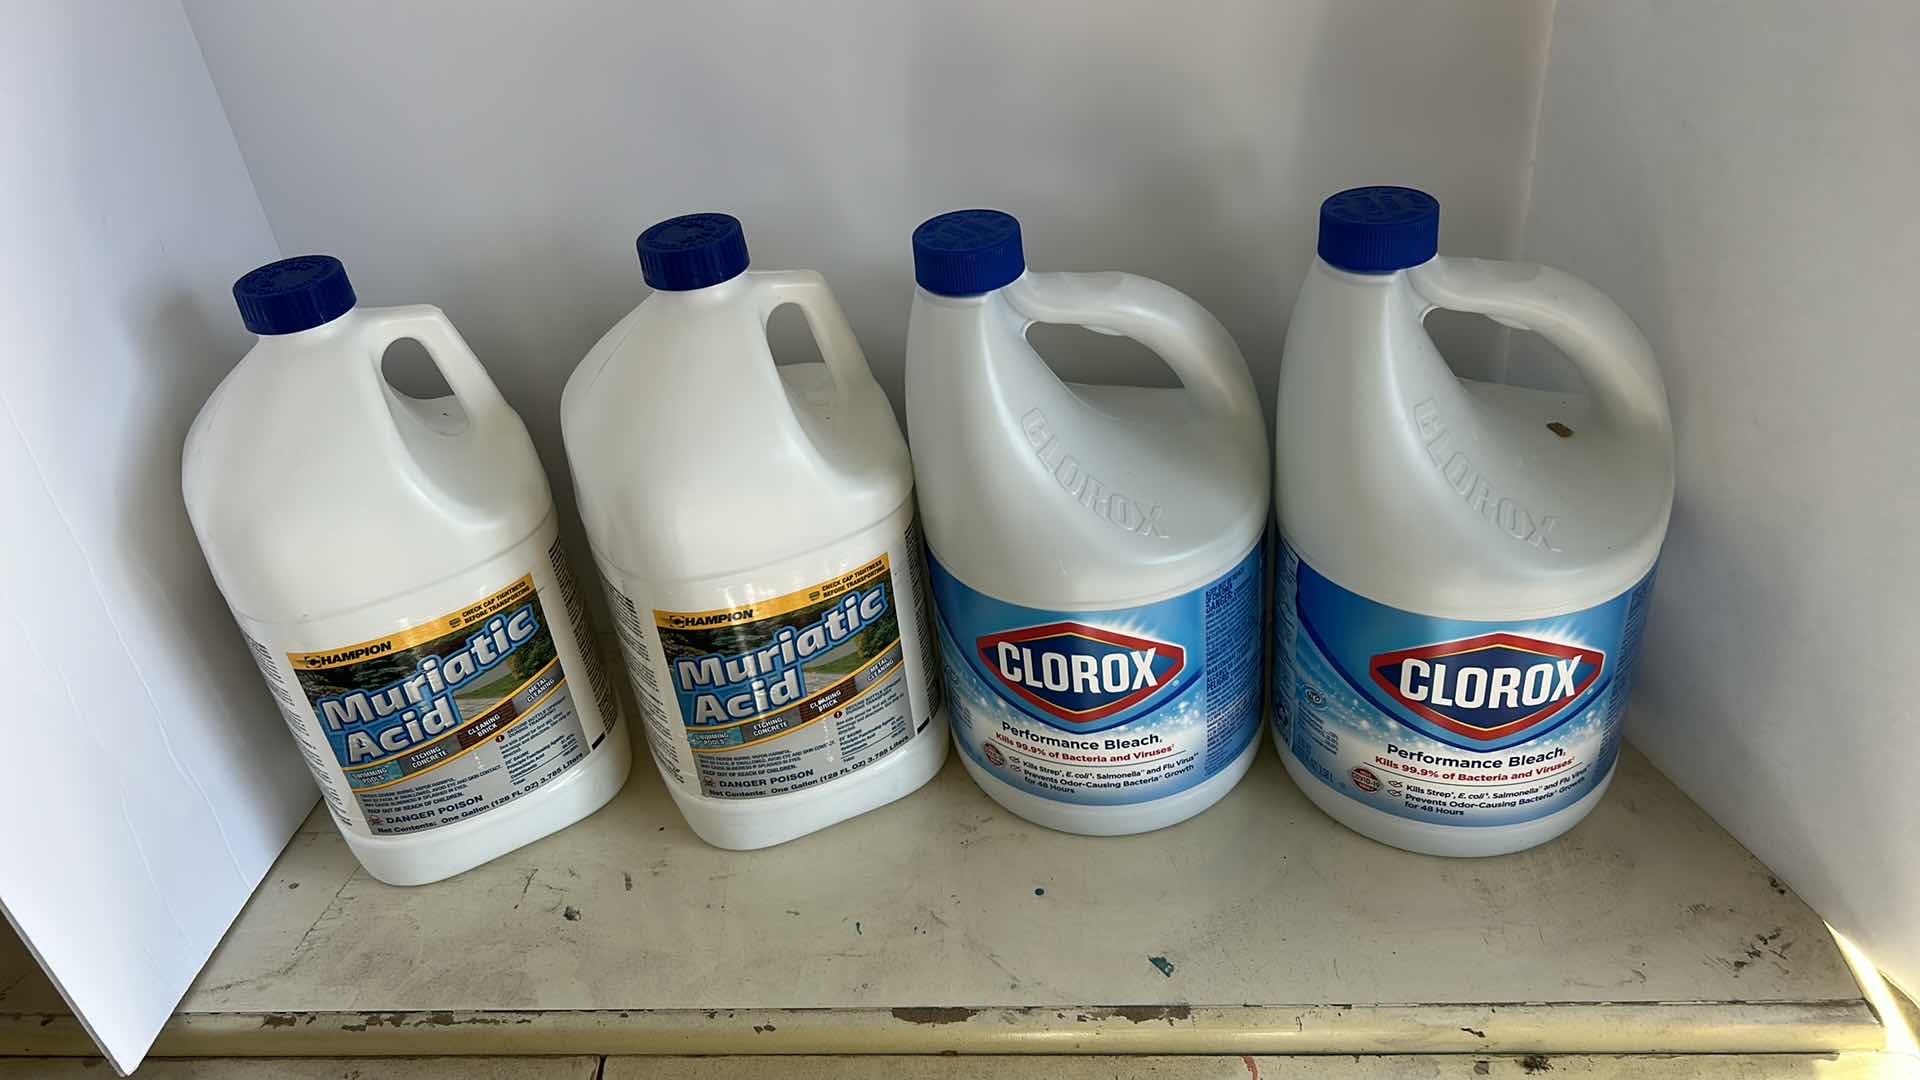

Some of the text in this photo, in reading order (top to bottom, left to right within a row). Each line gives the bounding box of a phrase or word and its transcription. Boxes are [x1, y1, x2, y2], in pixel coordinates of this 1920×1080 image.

[1020, 407, 1169, 539] CLOROX
[1414, 397, 1564, 553] CLOROX
[843, 575, 853, 583] CAP
[462, 605, 482, 617] CHECK
[484, 598, 495, 607] CAP
[670, 609, 753, 628] CHAMPION
[676, 587, 886, 691] Muriatic
[304, 641, 392, 668] CHAMPION
[870, 658, 888, 672] METAL
[320, 608, 537, 731] Muriatic
[867, 659, 894, 681] CLEANING
[997, 640, 1158, 695] CLOROX
[528, 678, 547, 694] METAL
[528, 679, 554, 702] CLEANING
[1399, 654, 1583, 710] CLOROX
[695, 671, 800, 724] Acid
[818, 699, 838, 712] BRICK
[347, 697, 457, 763] Acid
[468, 714, 500, 735] CLEANING
[478, 723, 498, 737] BRICK
[753, 722, 787, 736] CONCRETE
[754, 717, 783, 730] ETCHING
[995, 731, 1014, 746] Kills
[1015, 741, 1046, 756] 99.9%
[1048, 750, 1059, 758] of
[1062, 752, 1107, 763] Bacteria
[1110, 753, 1130, 762] and
[1002, 721, 1100, 751] Performance
[411, 747, 441, 761] ETCHING
[412, 751, 447, 768] CONCRETE
[1387, 743, 1503, 769] Performance
[720, 769, 814, 788] DANGER POISON
[791, 779, 818, 790] Gallon
[820, 771, 838, 783] (128
[840, 766, 850, 775] FL
[852, 760, 866, 770] OZ)
[1022, 760, 1038, 771] Kills
[1146, 766, 1161, 775] and
[1163, 762, 1175, 771] Flu
[1024, 769, 1059, 785] Prevents
[1060, 778, 1121, 789] Odor-Causing
[1164, 764, 1194, 779] Growth
[1375, 755, 1399, 770] Kills
[1401, 764, 1439, 778] 99.9%
[1442, 772, 1456, 780] of
[1458, 772, 1508, 782] Bacteria
[1511, 770, 1533, 780] and
[441, 814, 459, 823] One
[462, 804, 489, 817] Gallon
[491, 796, 510, 808] (128
[512, 790, 523, 798] FL
[525, 782, 539, 792] OZ)
[540, 768, 562, 784] 3.785
[1025, 777, 1036, 785] for
[1049, 783, 1075, 794] Hours
[1405, 794, 1447, 807] Prevents
[1449, 799, 1517, 809] Odor-Causing
[1559, 777, 1586, 793] Growth
[1406, 784, 1425, 794] Kills
[1543, 781, 1559, 791] and
[1559, 776, 1571, 786] Flu
[386, 796, 483, 823] DANGER POISON
[1404, 801, 1465, 816] for 48 Hours
